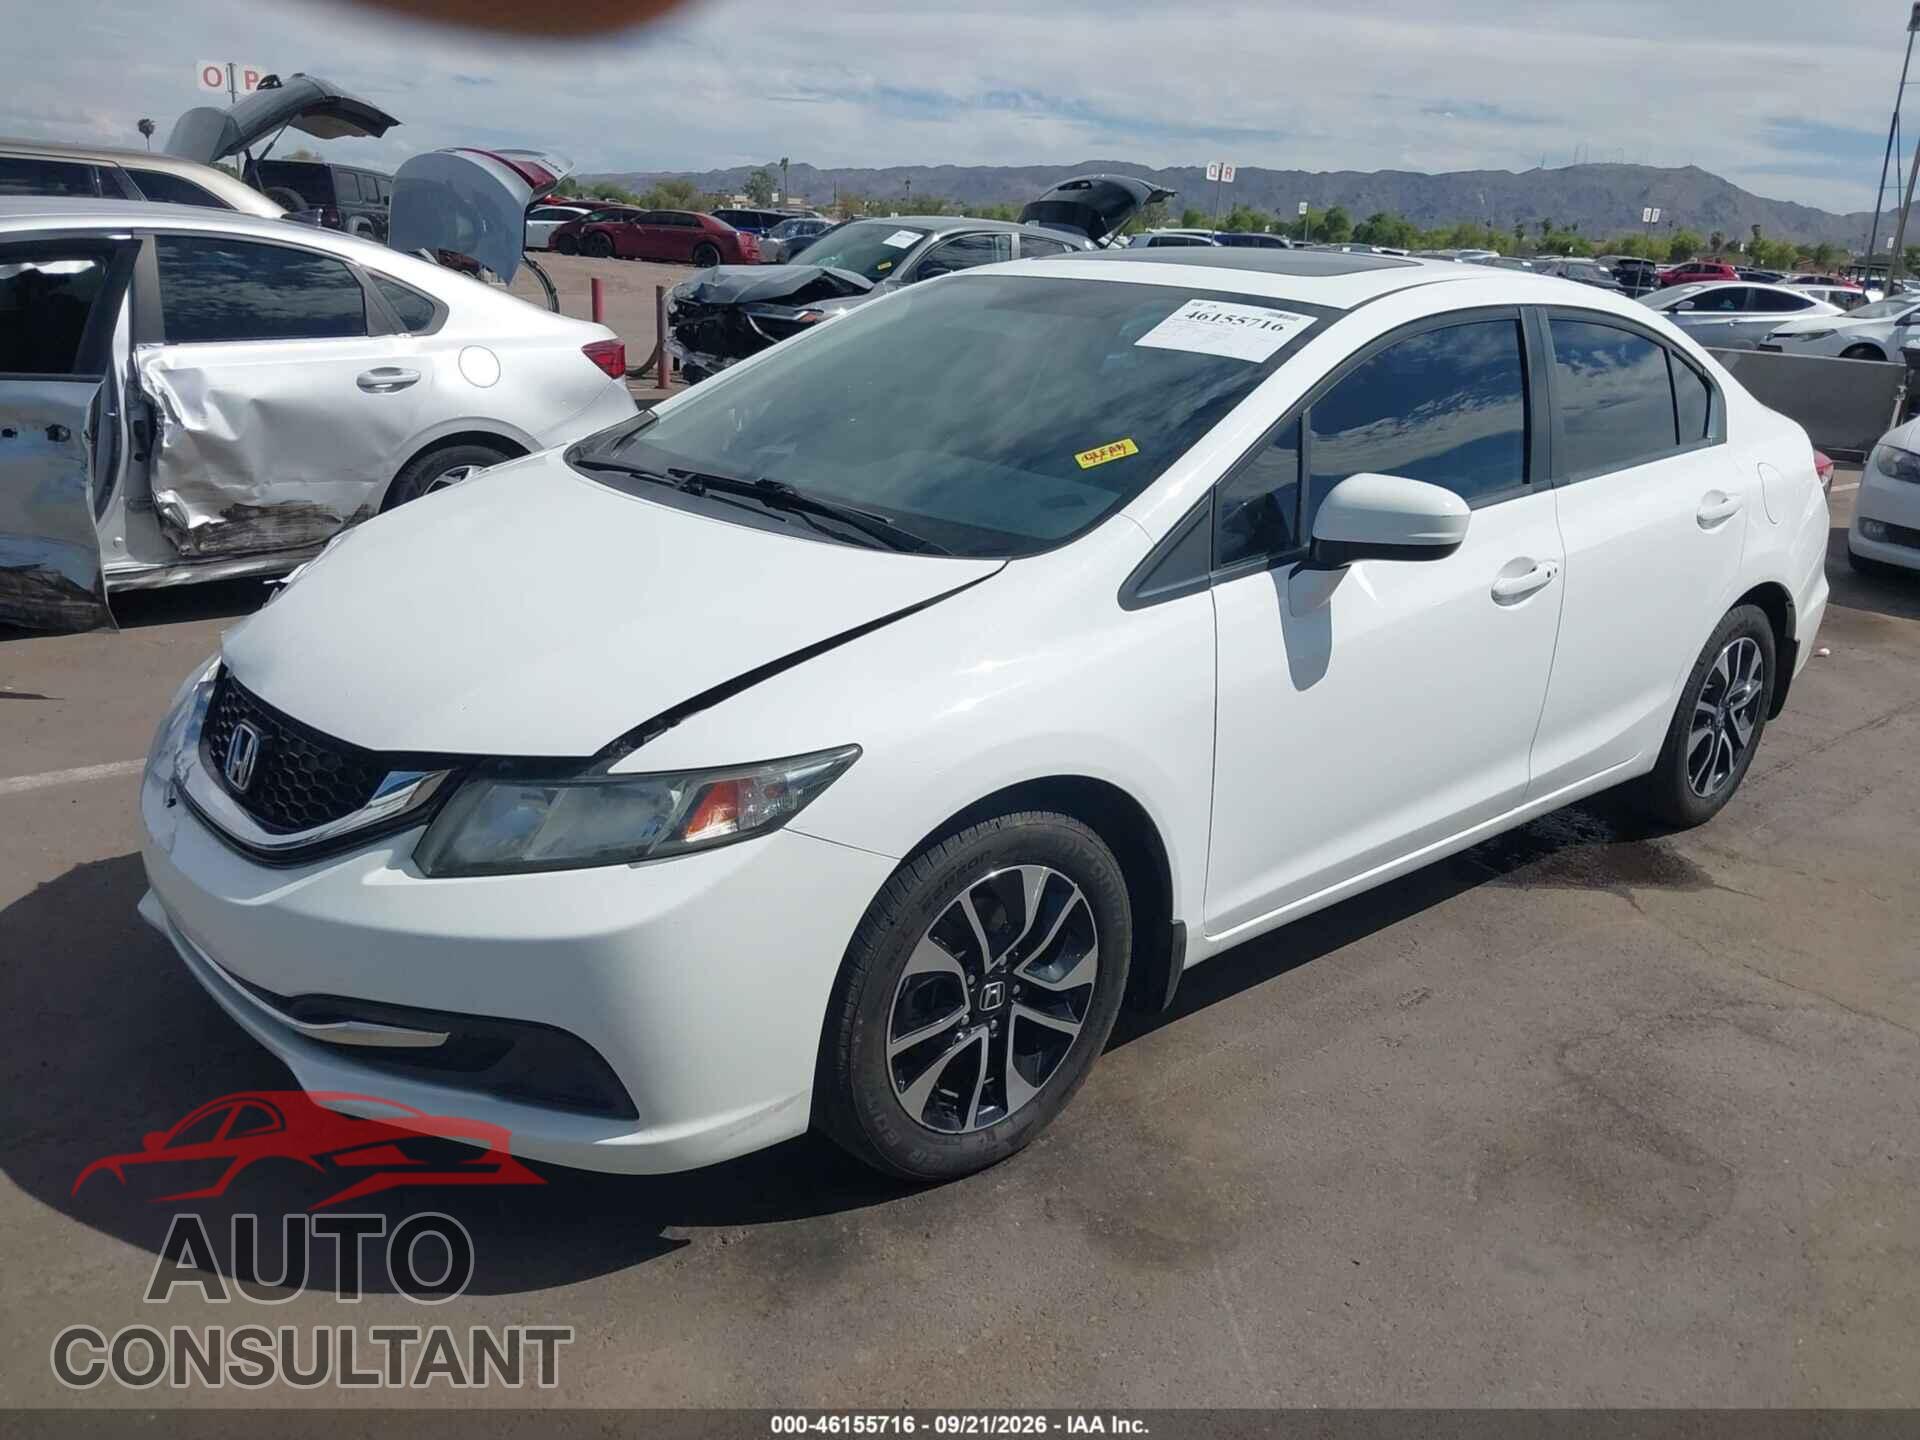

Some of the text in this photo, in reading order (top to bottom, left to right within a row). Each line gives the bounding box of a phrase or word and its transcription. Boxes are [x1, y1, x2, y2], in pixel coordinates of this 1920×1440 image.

[203, 66, 222, 87] O
[244, 70, 258, 90] P
[1185, 310, 1285, 332] 46155716
